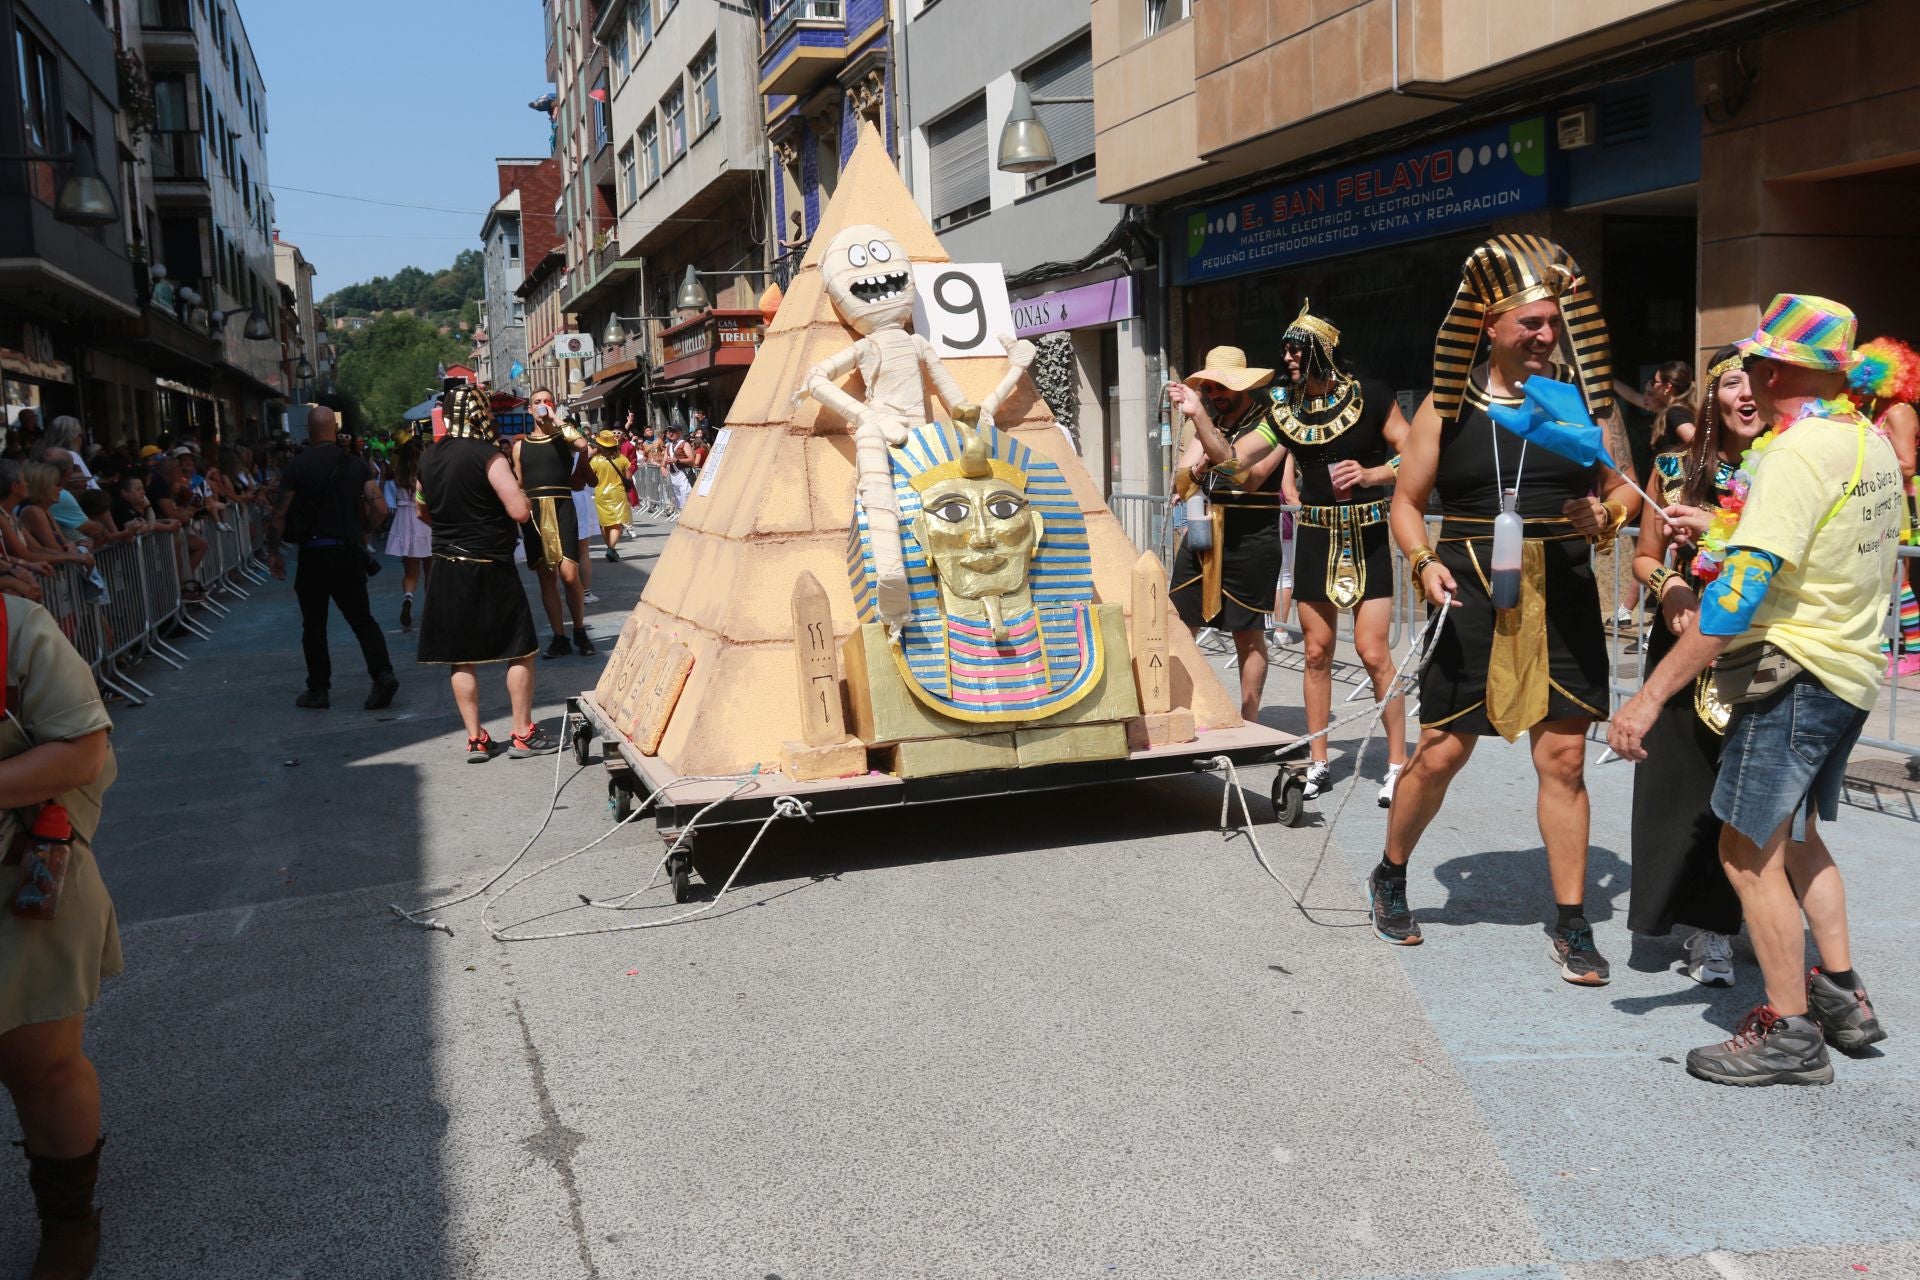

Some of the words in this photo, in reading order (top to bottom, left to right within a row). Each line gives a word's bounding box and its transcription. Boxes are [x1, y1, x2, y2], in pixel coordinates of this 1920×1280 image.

[1241, 203, 1264, 230] E.
[1273, 184, 1324, 223] SAN
[1336, 149, 1453, 207] PELAYO
[1202, 250, 1246, 270] PEQUEÑO
[1249, 224, 1359, 259] ELECTRODOMESTICO
[1370, 215, 1409, 233] VENTA
[1414, 211, 1422, 222] Y
[1427, 188, 1520, 221] REPARACION
[1240, 225, 1288, 246] MATERIAL
[1291, 210, 1351, 234] ELECTRICO
[1364, 186, 1454, 217] ELECTRONICA
[718, 320, 738, 328] CASA
[933, 271, 987, 350] 9
[1010, 302, 1050, 330] ONAS
[1842, 479, 1876, 497] Entre
[1862, 506, 1872, 522] la
